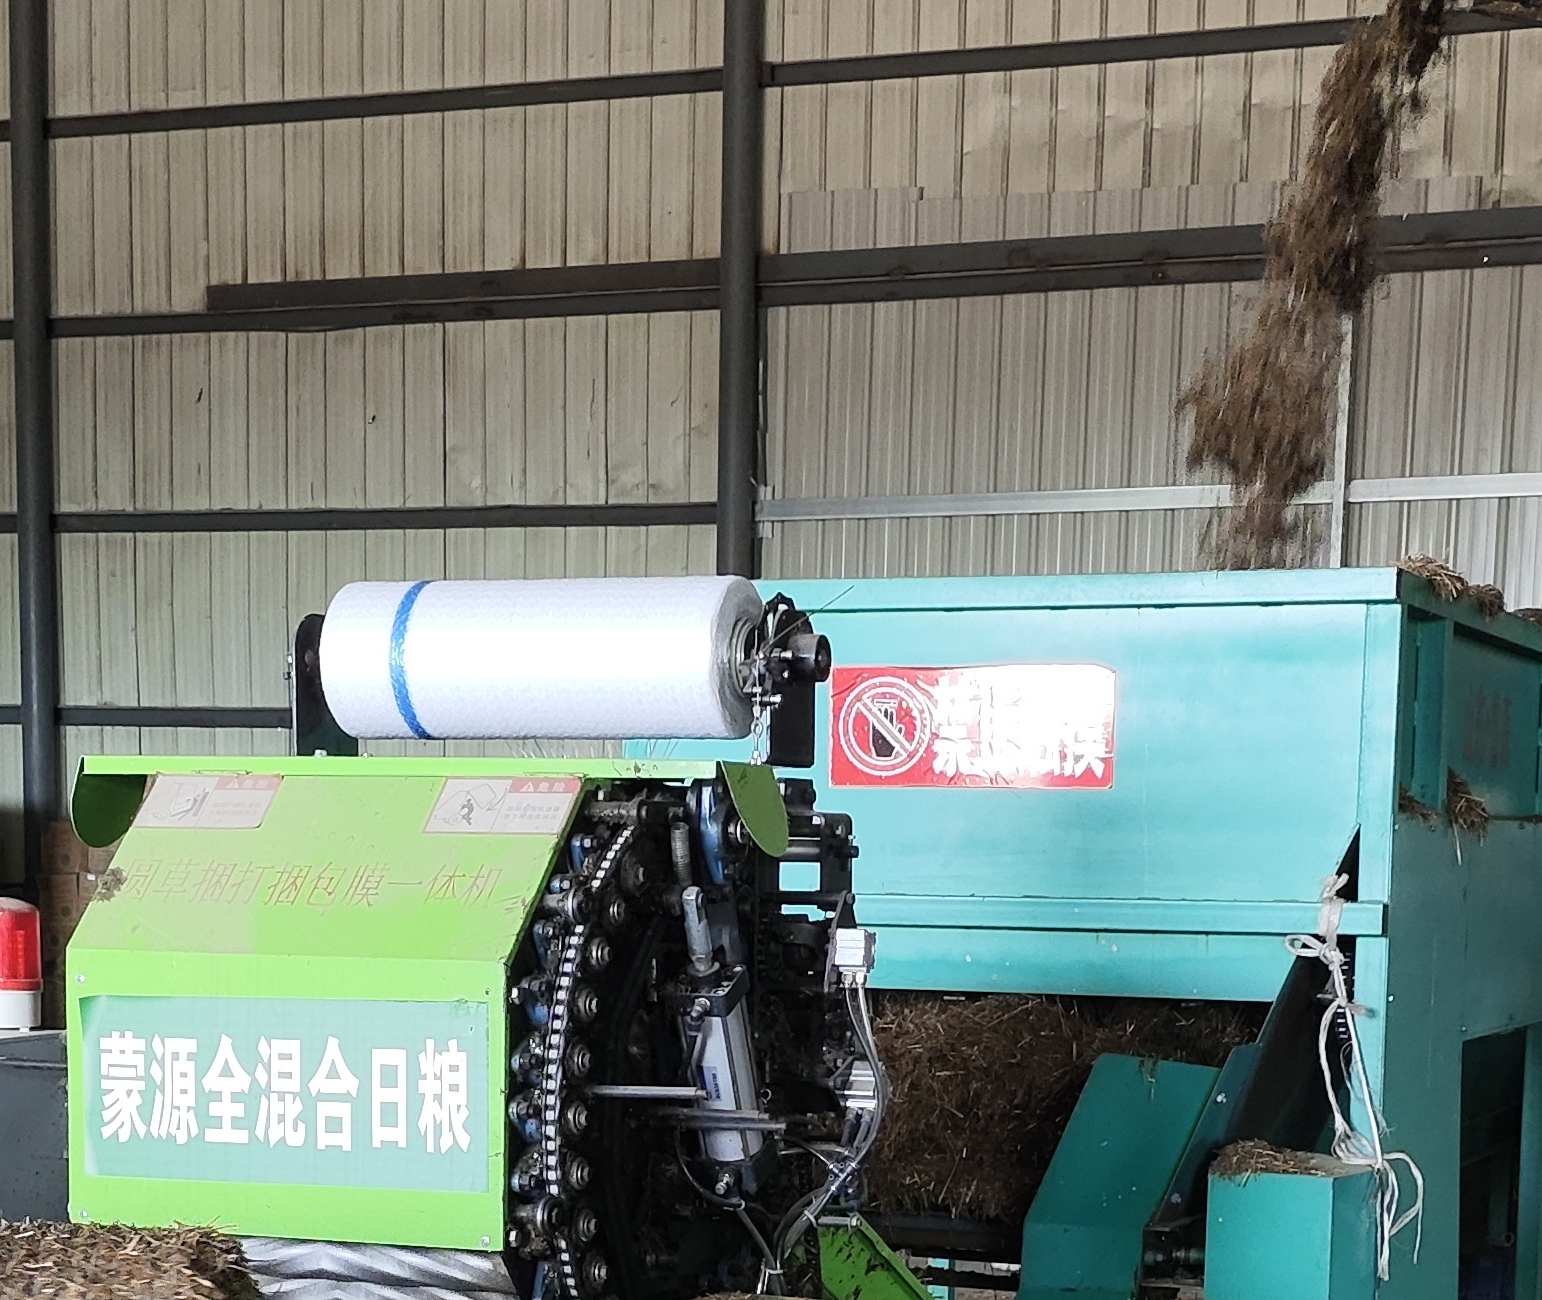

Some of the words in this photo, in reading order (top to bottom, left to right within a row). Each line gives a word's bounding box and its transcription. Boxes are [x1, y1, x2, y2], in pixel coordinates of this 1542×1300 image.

[99, 1032, 471, 1154] 蒙源全混合日粮
